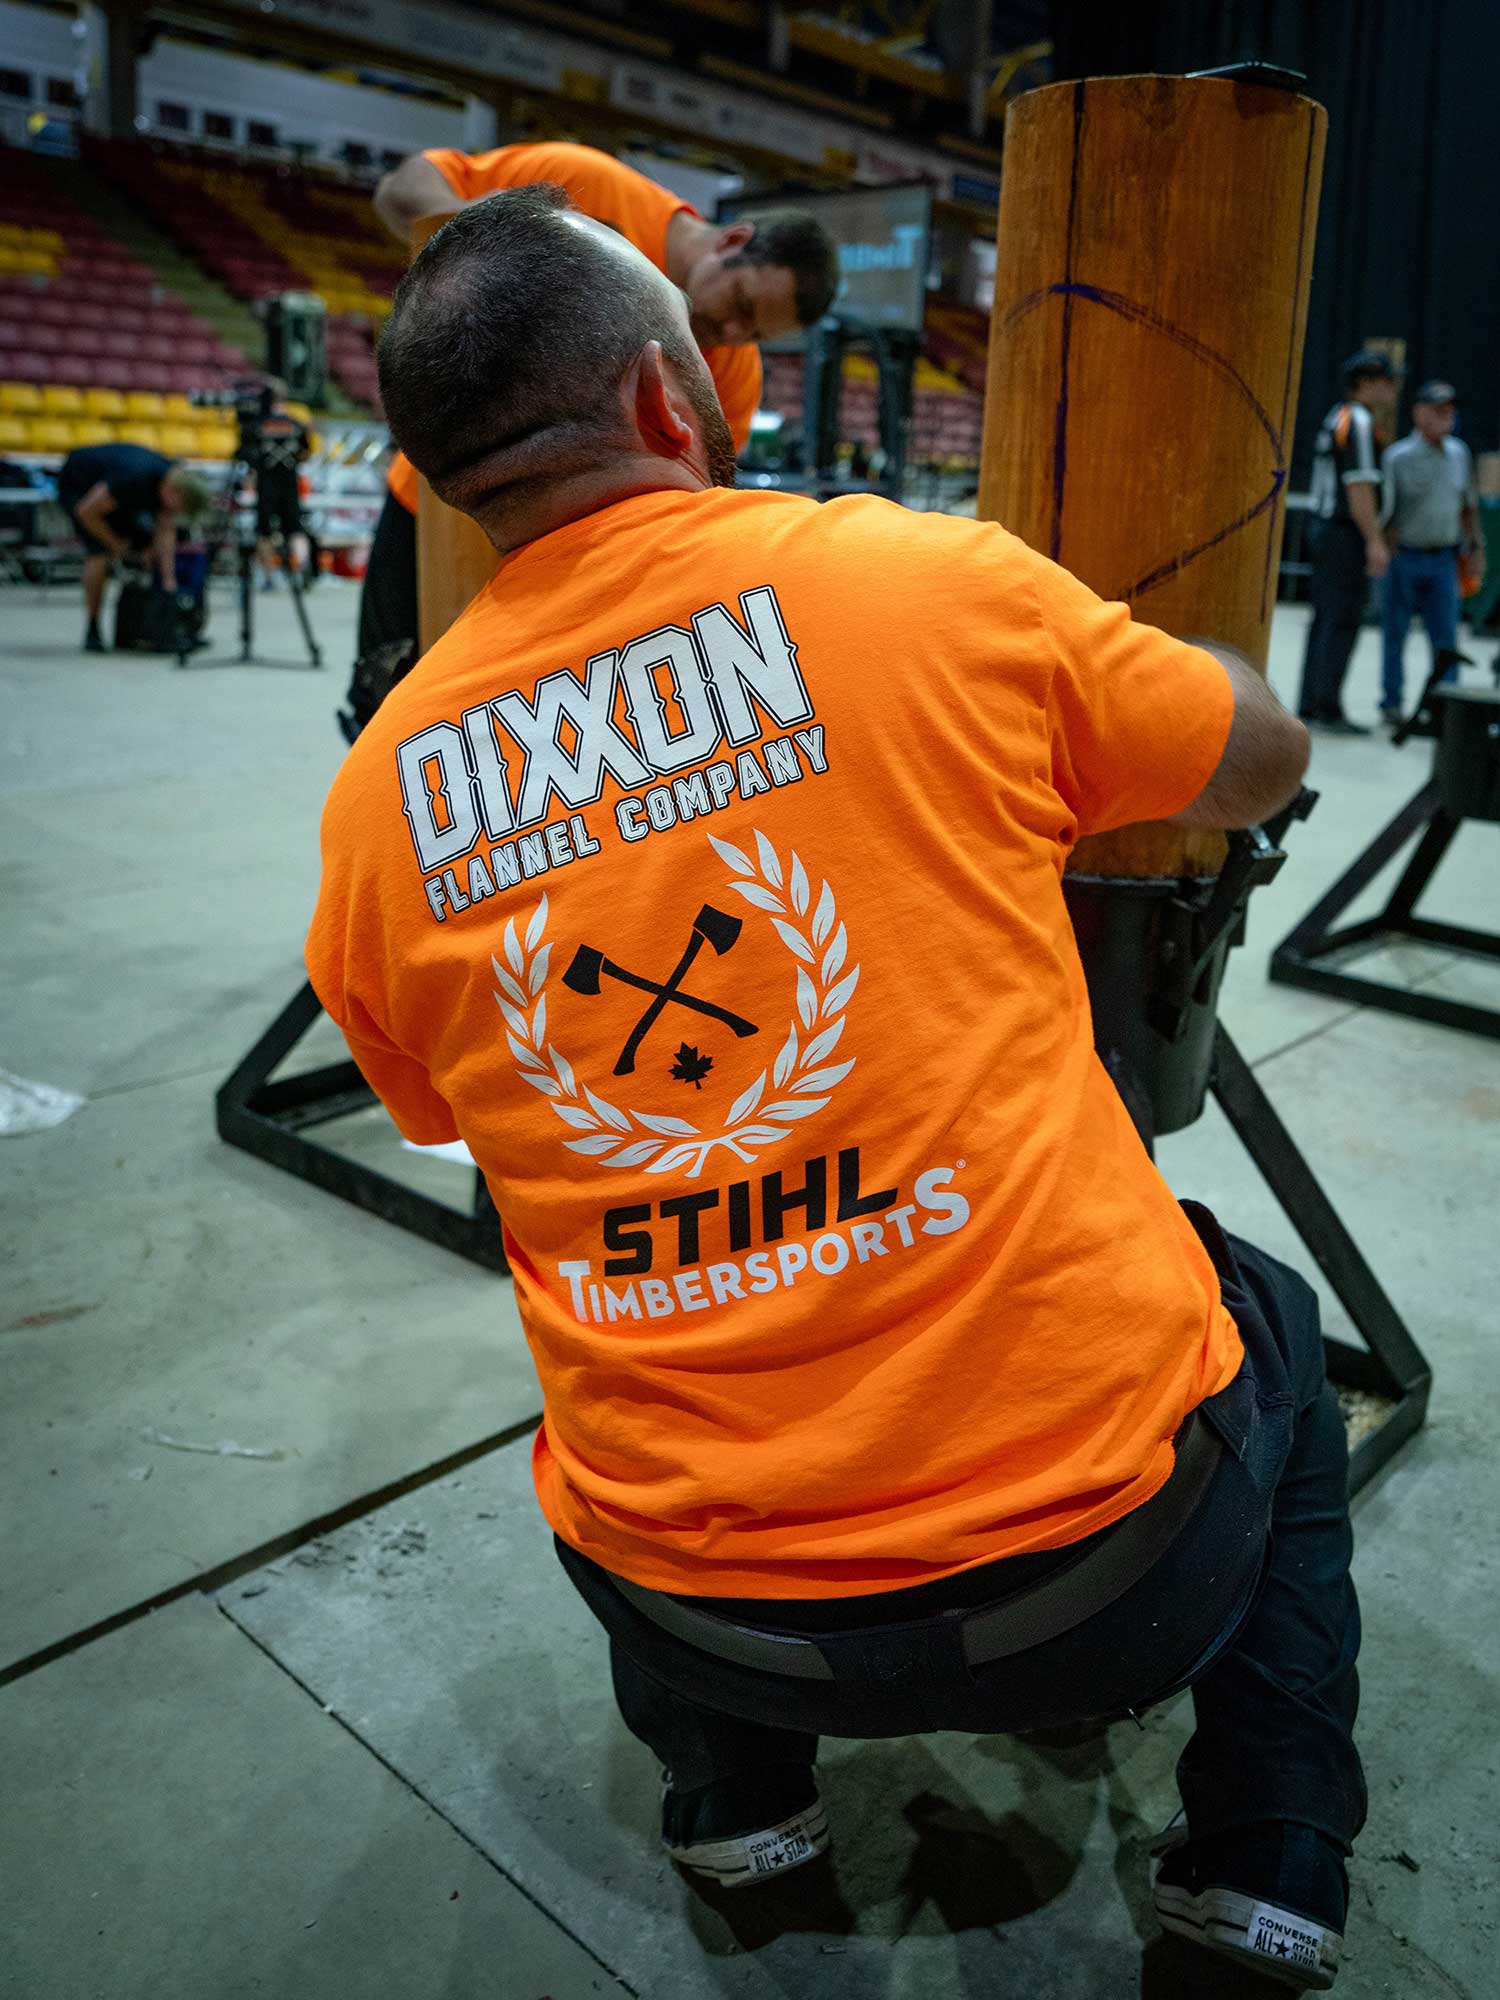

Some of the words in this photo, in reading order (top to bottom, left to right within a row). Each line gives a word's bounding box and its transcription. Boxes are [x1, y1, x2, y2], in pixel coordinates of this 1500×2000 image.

[396, 585, 815, 874] DIXXON
[423, 814, 601, 922] FLANNEL
[613, 724, 829, 842] COMPANY
[603, 1146, 898, 1277] STIHL
[750, 1824, 802, 1854] CONVERSE
[755, 1853, 776, 1873] ALL
[783, 1835, 809, 1862] STAR
[1253, 1928, 1274, 1954] ALL
[1258, 1916, 1319, 1948] CONVERSE
